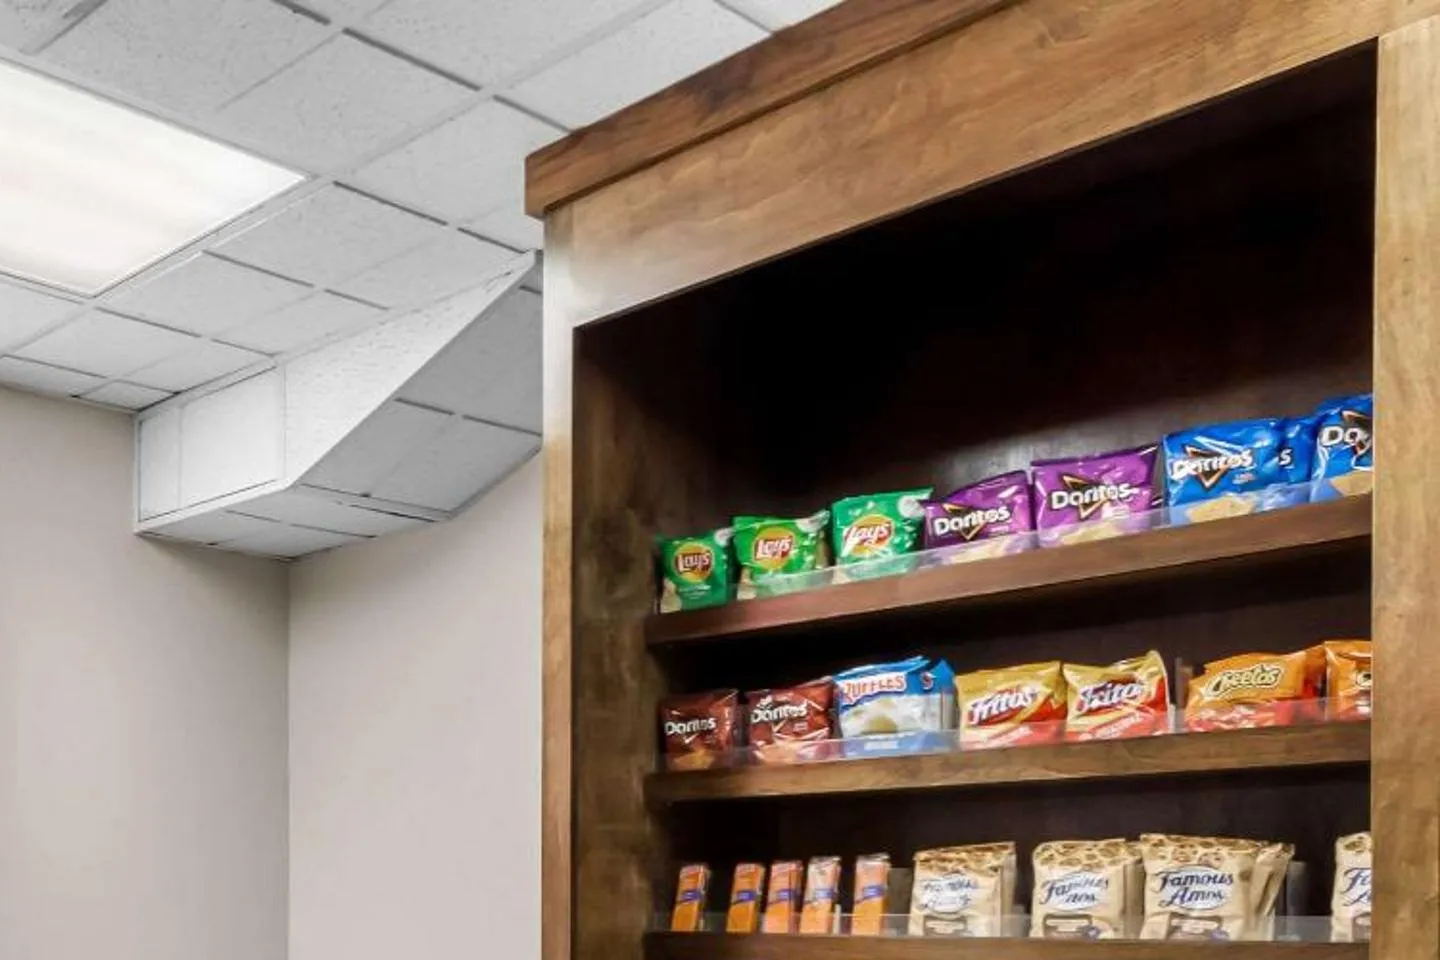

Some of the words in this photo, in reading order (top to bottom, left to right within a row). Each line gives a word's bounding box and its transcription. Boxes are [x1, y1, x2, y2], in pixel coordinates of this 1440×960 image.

[1173, 449, 1252, 479] Doritos
[1052, 482, 1133, 509] Doritos
[934, 505, 1010, 535] Doritos
[750, 701, 808, 724] Doritos
[664, 716, 717, 736] Doritos
[1156, 869, 1235, 892] Famous
[1160, 886, 1225, 907] Amos
